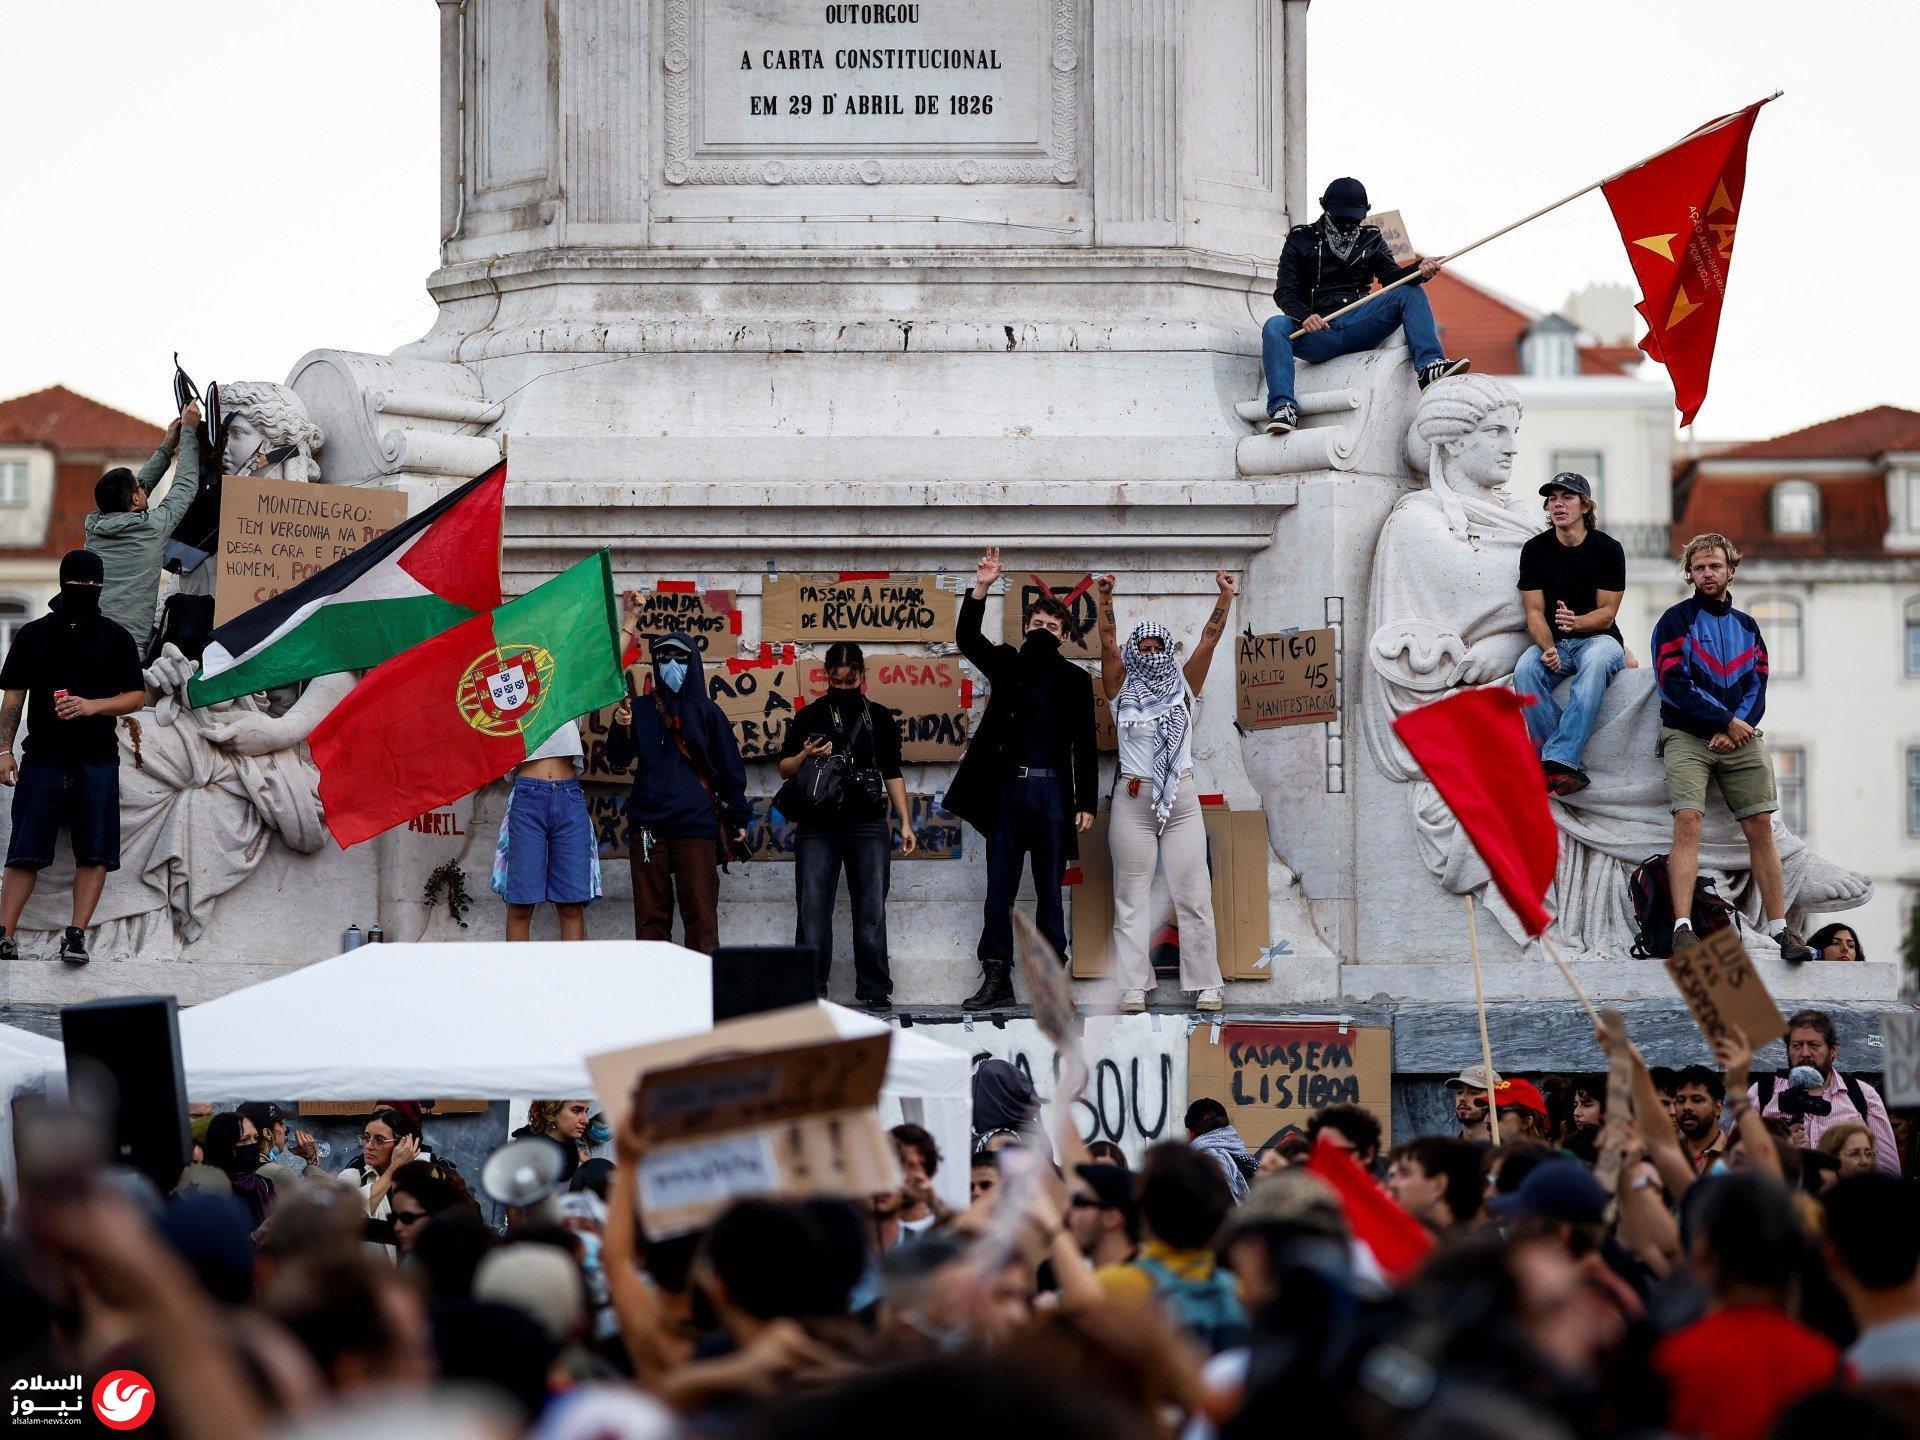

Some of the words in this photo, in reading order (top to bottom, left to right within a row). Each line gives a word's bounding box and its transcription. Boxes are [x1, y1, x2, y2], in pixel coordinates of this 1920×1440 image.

[826, 4, 919, 24] OUTORGOU
[741, 50, 752, 70] A
[763, 50, 824, 69] CARTA
[836, 49, 1002, 69] CONSTITUCIONAL
[751, 96, 777, 115] EM
[789, 95, 811, 115] 29
[915, 96, 938, 114] DE
[950, 95, 993, 115] 1826
[1689, 243, 1711, 289] PORTUGAL
[257, 494, 372, 522] MONTENEGRO:
[237, 517, 263, 535] TEM
[271, 521, 331, 541] VERGONHA
[338, 528, 356, 541] NA
[226, 541, 263, 555] DESSA
[272, 543, 305, 558] CARA
[316, 546, 323, 558] E
[643, 592, 704, 614] AINDA
[800, 586, 856, 603] PASSAR
[801, 613, 818, 628] DE
[822, 602, 935, 631] REVOLUÇÃO
[1240, 636, 1316, 665] ARTIGO
[1240, 669, 1285, 685] DIREITO
[1304, 663, 1329, 689] 45
